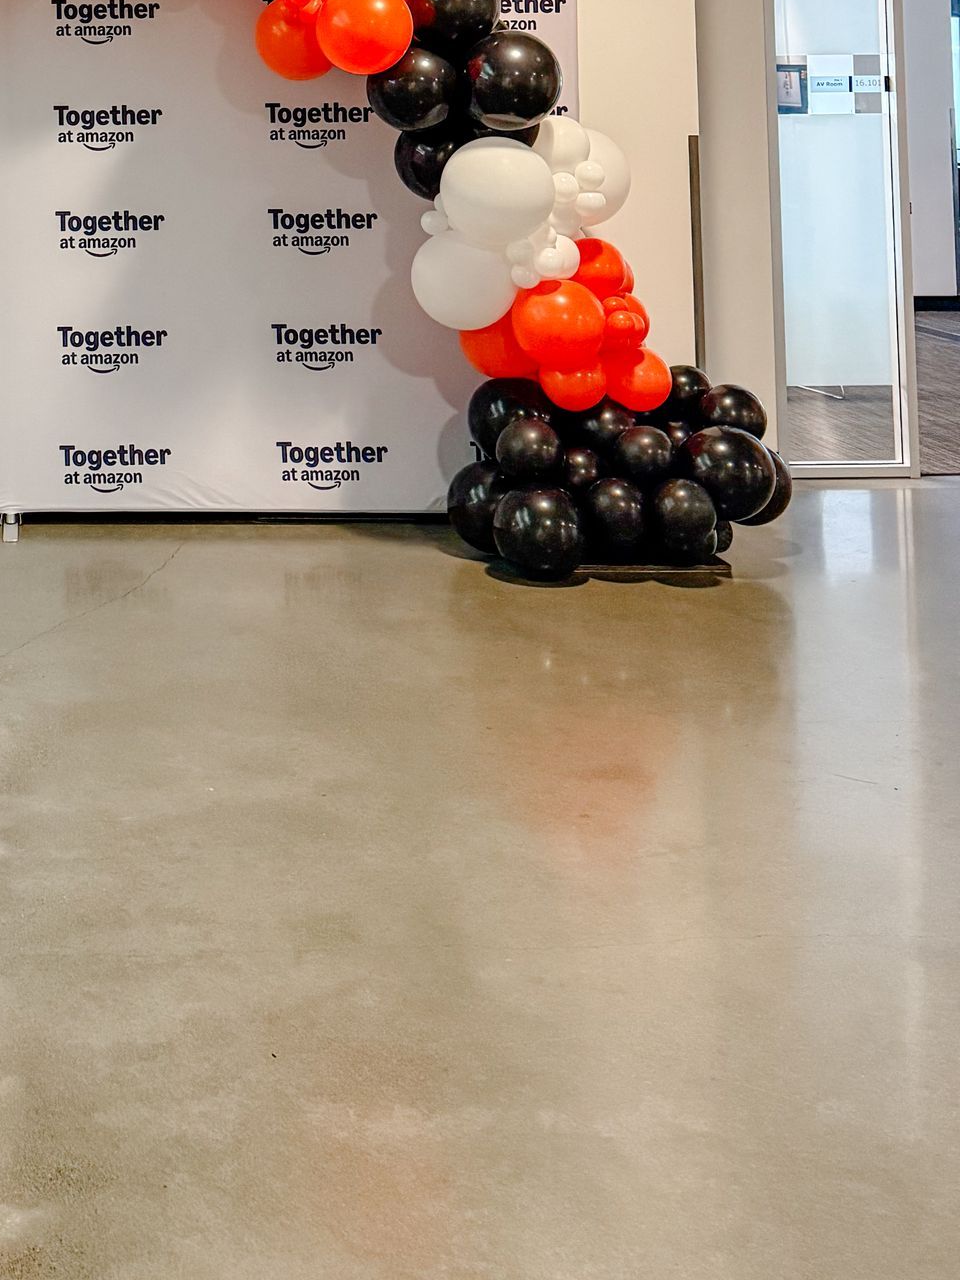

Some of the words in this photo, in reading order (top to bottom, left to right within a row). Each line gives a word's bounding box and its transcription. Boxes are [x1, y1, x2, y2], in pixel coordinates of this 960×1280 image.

[51, 0, 160, 24] Together
[56, 24, 71, 36] at
[74, 24, 131, 37] amazon
[855, 79, 881, 87] 16.101
[53, 105, 162, 130] Together
[265, 101, 375, 128] Together
[58, 131, 73, 142] at
[77, 131, 133, 143] amazon
[270, 128, 285, 140] at
[288, 128, 346, 141] amazon
[55, 210, 165, 236] Together
[268, 208, 378, 234] Together
[60, 236, 75, 249] at
[79, 237, 136, 250] amazon
[273, 234, 288, 247] at
[291, 235, 349, 248] amazon
[57, 326, 168, 351] Together
[271, 324, 382, 349] Together
[62, 352, 77, 365] at
[81, 352, 138, 366] amazon
[277, 349, 292, 362] at
[295, 350, 353, 363] amazon
[59, 444, 171, 471] Together
[276, 441, 388, 467] Together
[65, 472, 80, 484] at
[84, 472, 142, 485] amazon
[282, 468, 298, 481] at
[301, 469, 360, 482] amazon
